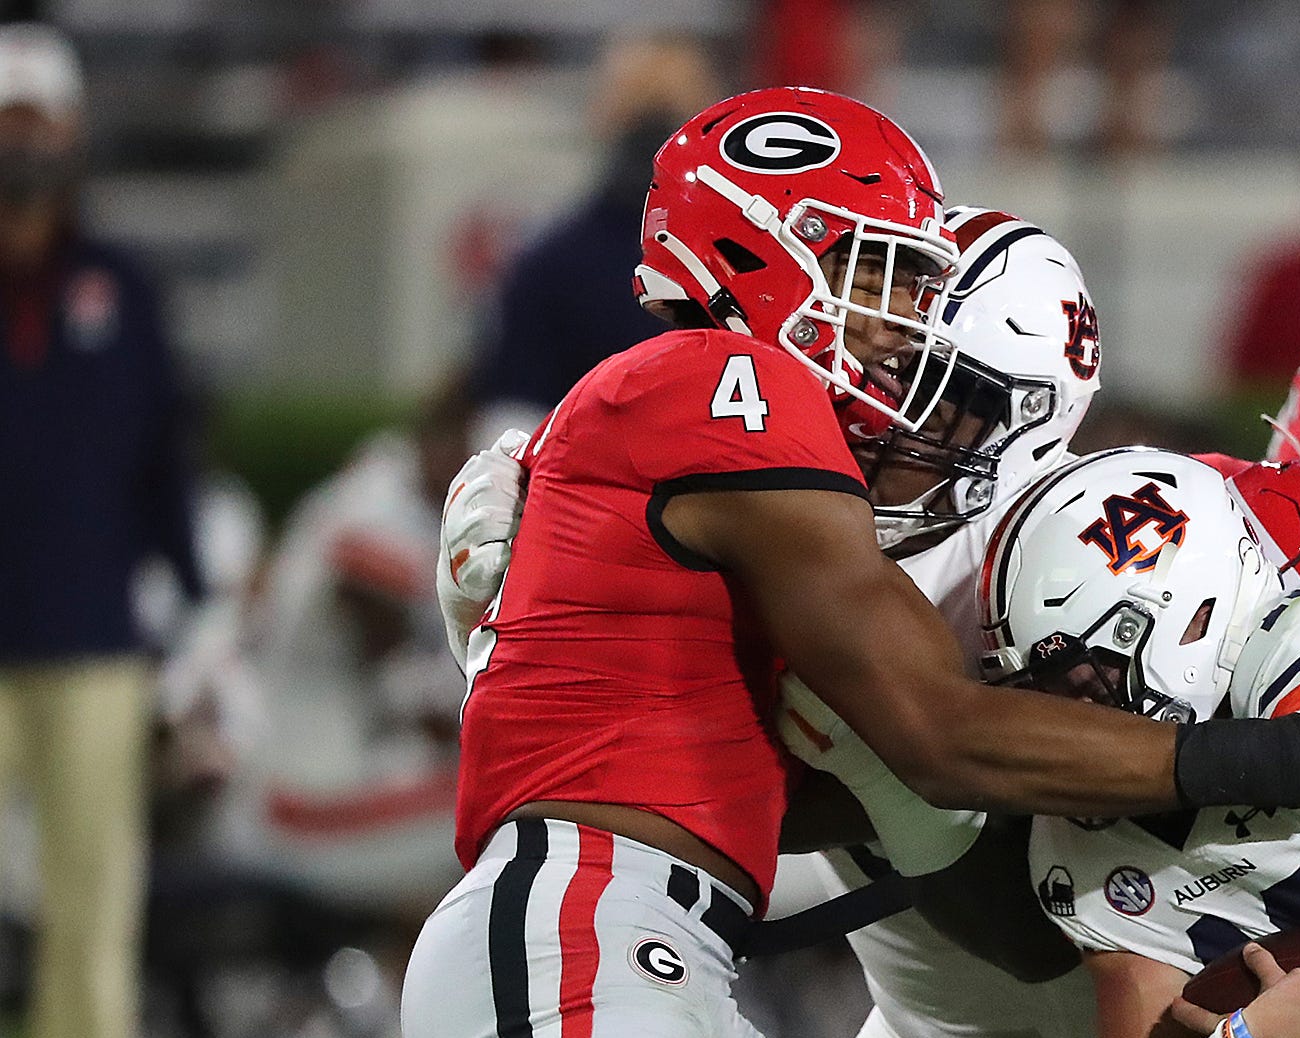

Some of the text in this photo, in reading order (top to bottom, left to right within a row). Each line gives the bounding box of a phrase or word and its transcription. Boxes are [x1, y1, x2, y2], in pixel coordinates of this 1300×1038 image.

[722, 113, 839, 172] G
[709, 354, 769, 432] 4
[1106, 868, 1153, 913] SEC
[1173, 857, 1257, 906] AUBURN
[634, 939, 686, 982] G
